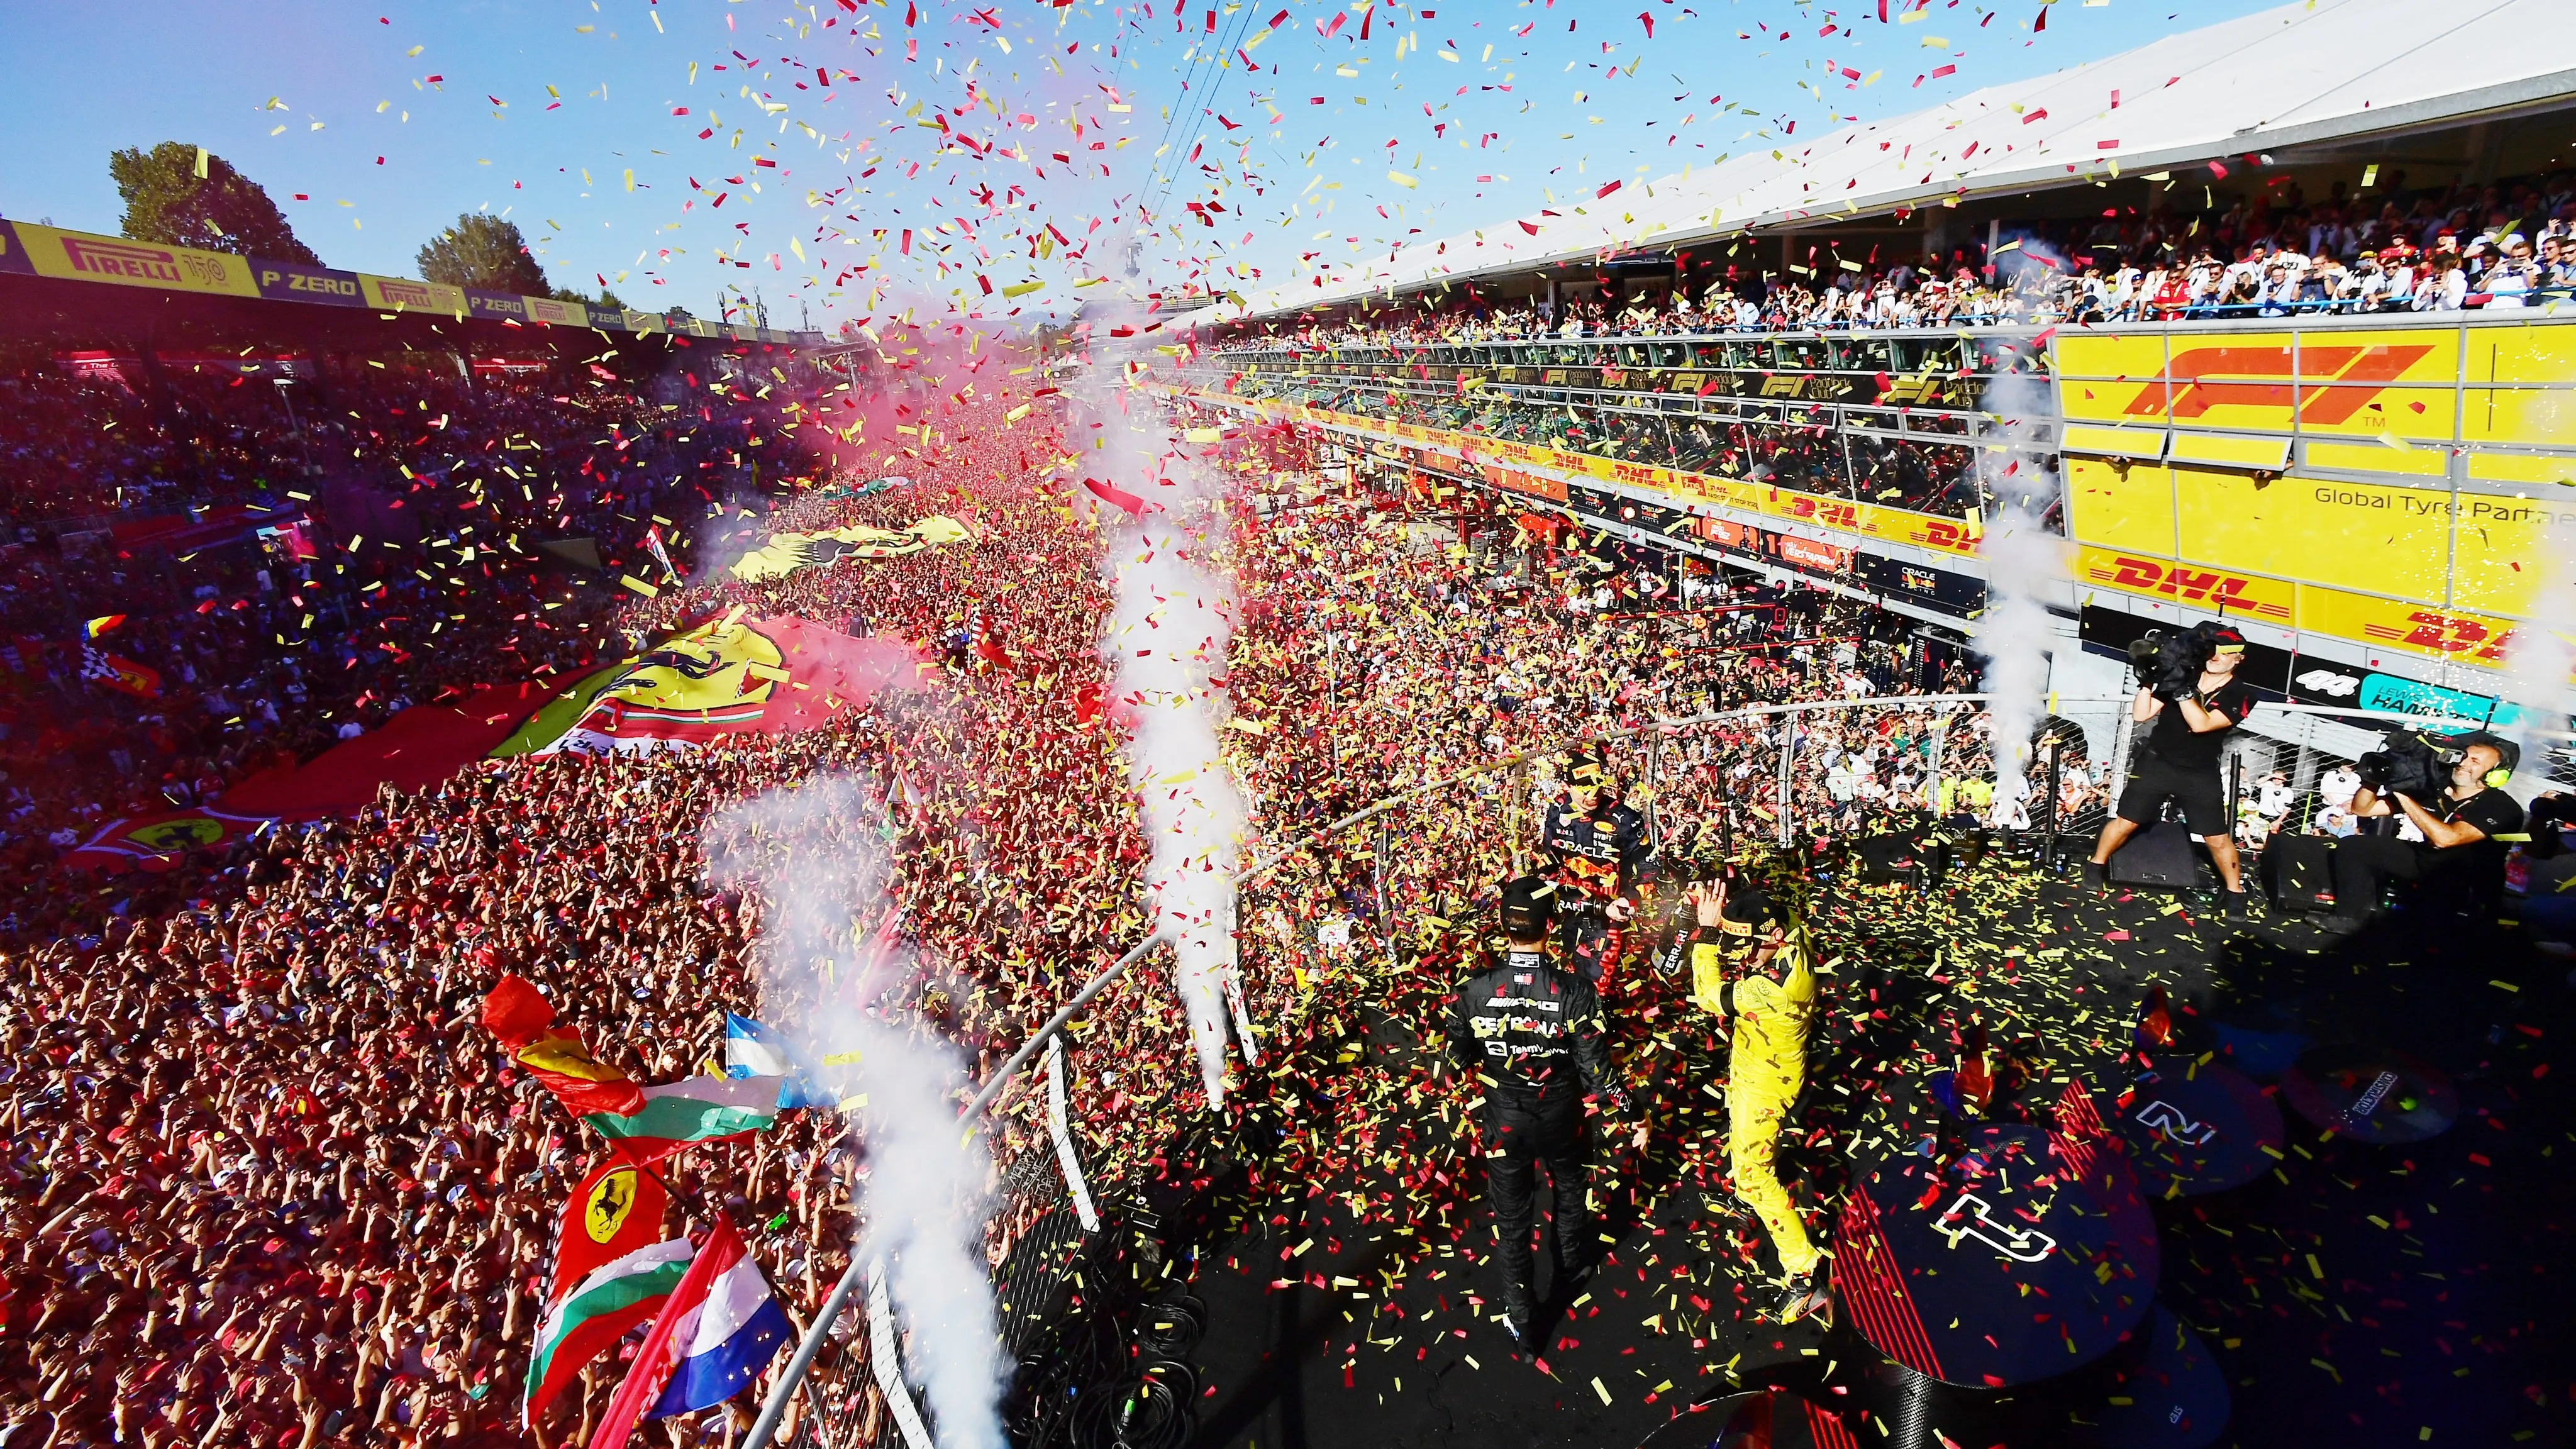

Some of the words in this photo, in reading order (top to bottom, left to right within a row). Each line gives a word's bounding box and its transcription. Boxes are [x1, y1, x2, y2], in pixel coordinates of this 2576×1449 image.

[60, 236, 182, 282] PIRELLI
[262, 270, 280, 287] P
[288, 273, 357, 296] ZERO
[471, 297, 480, 308] P
[485, 299, 521, 313] ZERO
[2363, 416, 2385, 428] TM
[1502, 443, 1531, 460] DHL
[1553, 453, 1588, 472] DHL
[2315, 488, 2390, 509] Global
[2399, 496, 2463, 515] Tyre
[1793, 497, 1858, 528] DHL
[1765, 534, 1776, 554] 1
[1785, 547, 1836, 566] VERSTAPPEN
[1901, 567, 1936, 580] ORACLE
[2114, 557, 2258, 611] DHL
[2296, 669, 2360, 697] 44
[2378, 686, 2423, 702] LEWIS
[1558, 838, 1614, 858] ORACLE
[1759, 918, 1776, 933] 150
